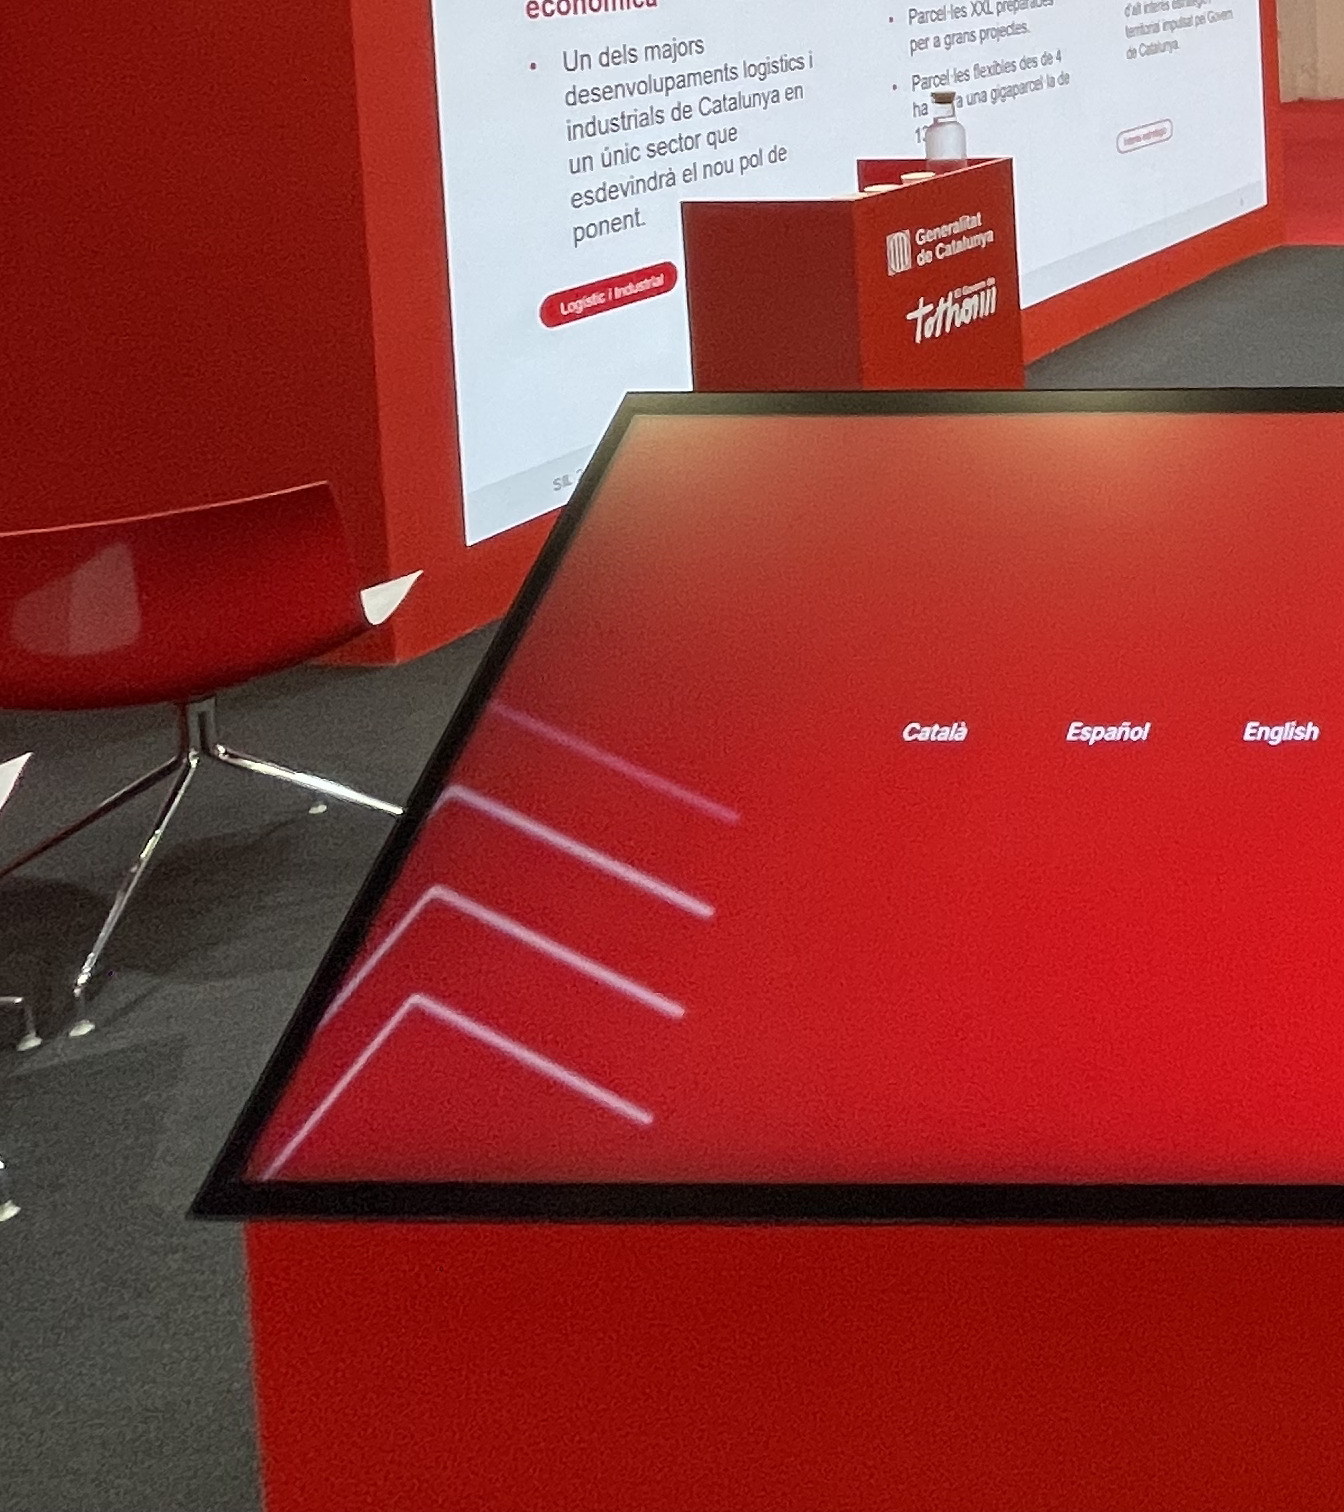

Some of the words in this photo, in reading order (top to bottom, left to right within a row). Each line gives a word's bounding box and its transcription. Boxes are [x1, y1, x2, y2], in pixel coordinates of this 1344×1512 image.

[971, 0, 994, 18] XXL
[562, 50, 592, 73] Un
[598, 43, 638, 68] dels
[644, 37, 705, 64] majors
[910, 36, 930, 57] per
[933, 35, 941, 48] a
[944, 28, 977, 50] grans
[565, 61, 739, 107] desenvolupaments
[973, 59, 1017, 81] flexibles
[1019, 54, 1038, 72] des
[1040, 50, 1054, 67] de
[566, 104, 665, 141] industrials
[670, 101, 693, 123] de
[698, 90, 780, 120] Catalunya
[785, 84, 805, 101] en
[912, 101, 929, 118] ha
[956, 94, 963, 109] a
[966, 90, 988, 107] una
[1057, 71, 1071, 86] de
[569, 154, 594, 175] un
[601, 143, 641, 169] únic
[646, 132, 702, 161] sector
[706, 124, 739, 149] que
[571, 175, 676, 210] esdevindrà
[682, 163, 697, 184] el
[702, 158, 734, 181] nou
[740, 149, 763, 175] pol
[767, 144, 788, 163] de
[573, 207, 647, 248] ponent.
[915, 212, 983, 246] Generalitat
[916, 249, 933, 267] de
[935, 230, 994, 261] Catalunya
[902, 721, 968, 743] Català
[1065, 721, 1151, 746] Español
[1243, 720, 1321, 746] English
